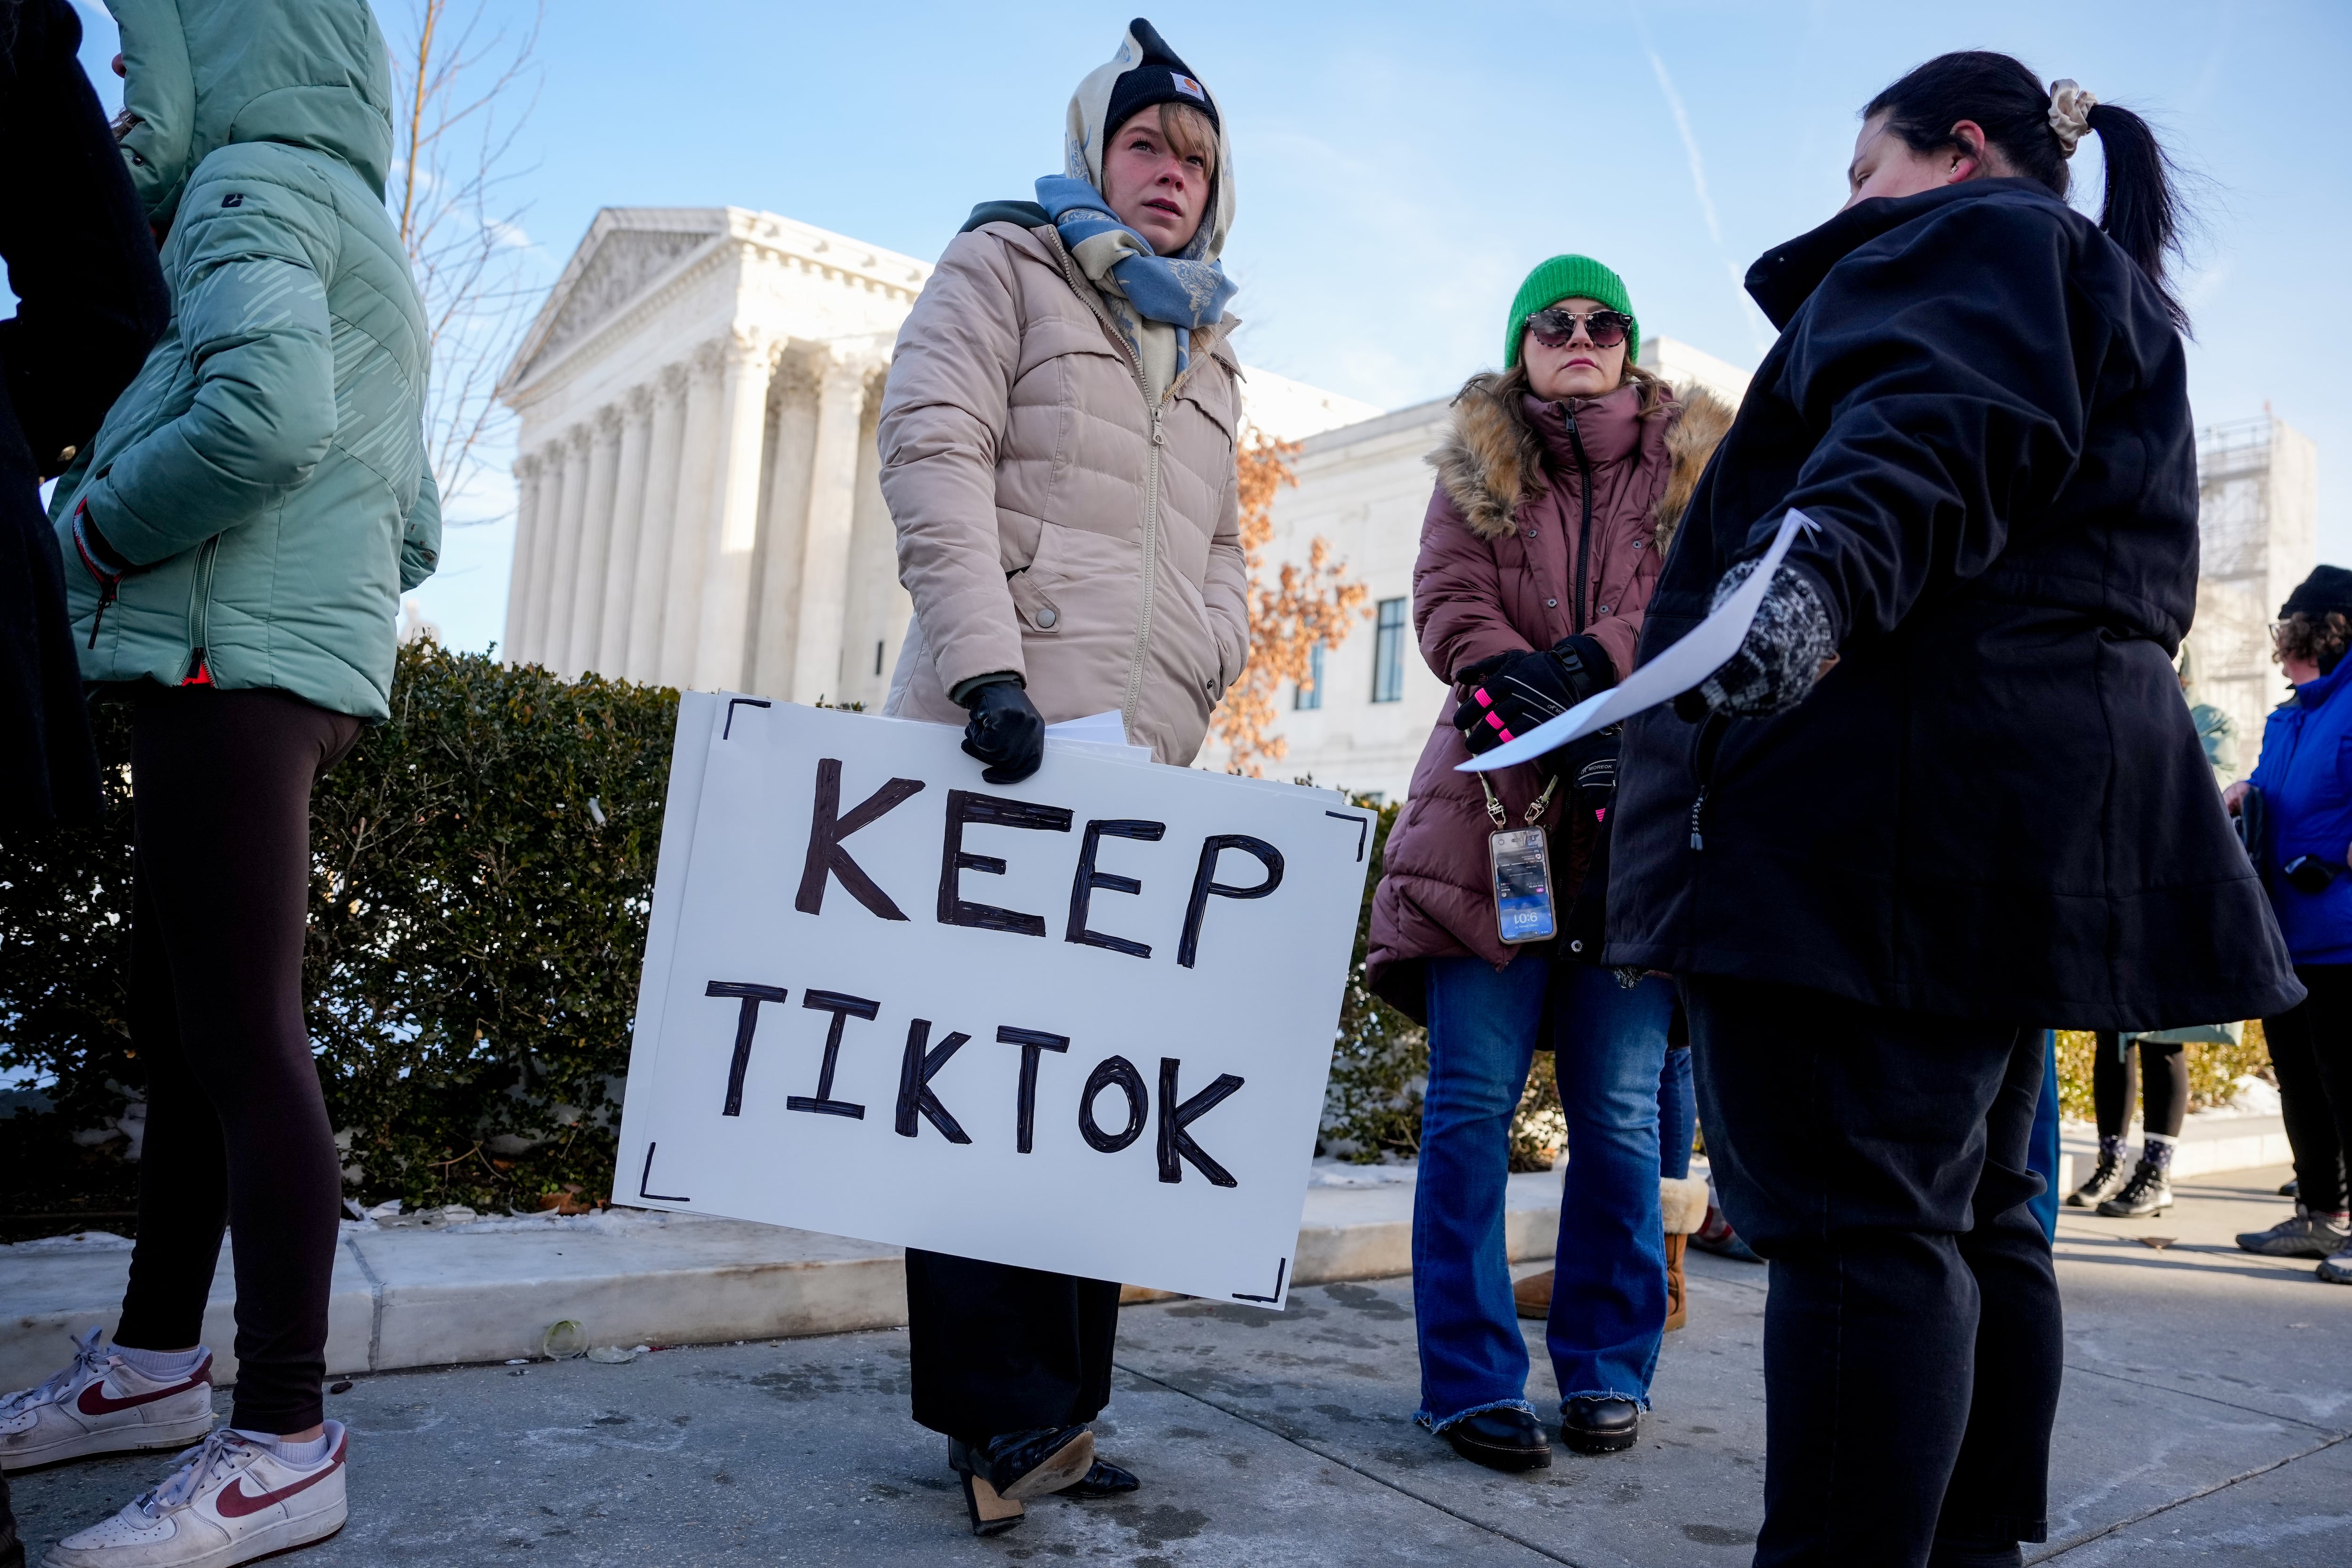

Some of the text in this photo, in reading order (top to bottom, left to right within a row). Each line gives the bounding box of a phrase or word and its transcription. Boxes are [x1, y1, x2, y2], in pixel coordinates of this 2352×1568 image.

[795, 758, 1285, 968] KEEP
[1514, 912, 1538, 924] 9:01
[705, 980, 1246, 1188] TIKTOK
